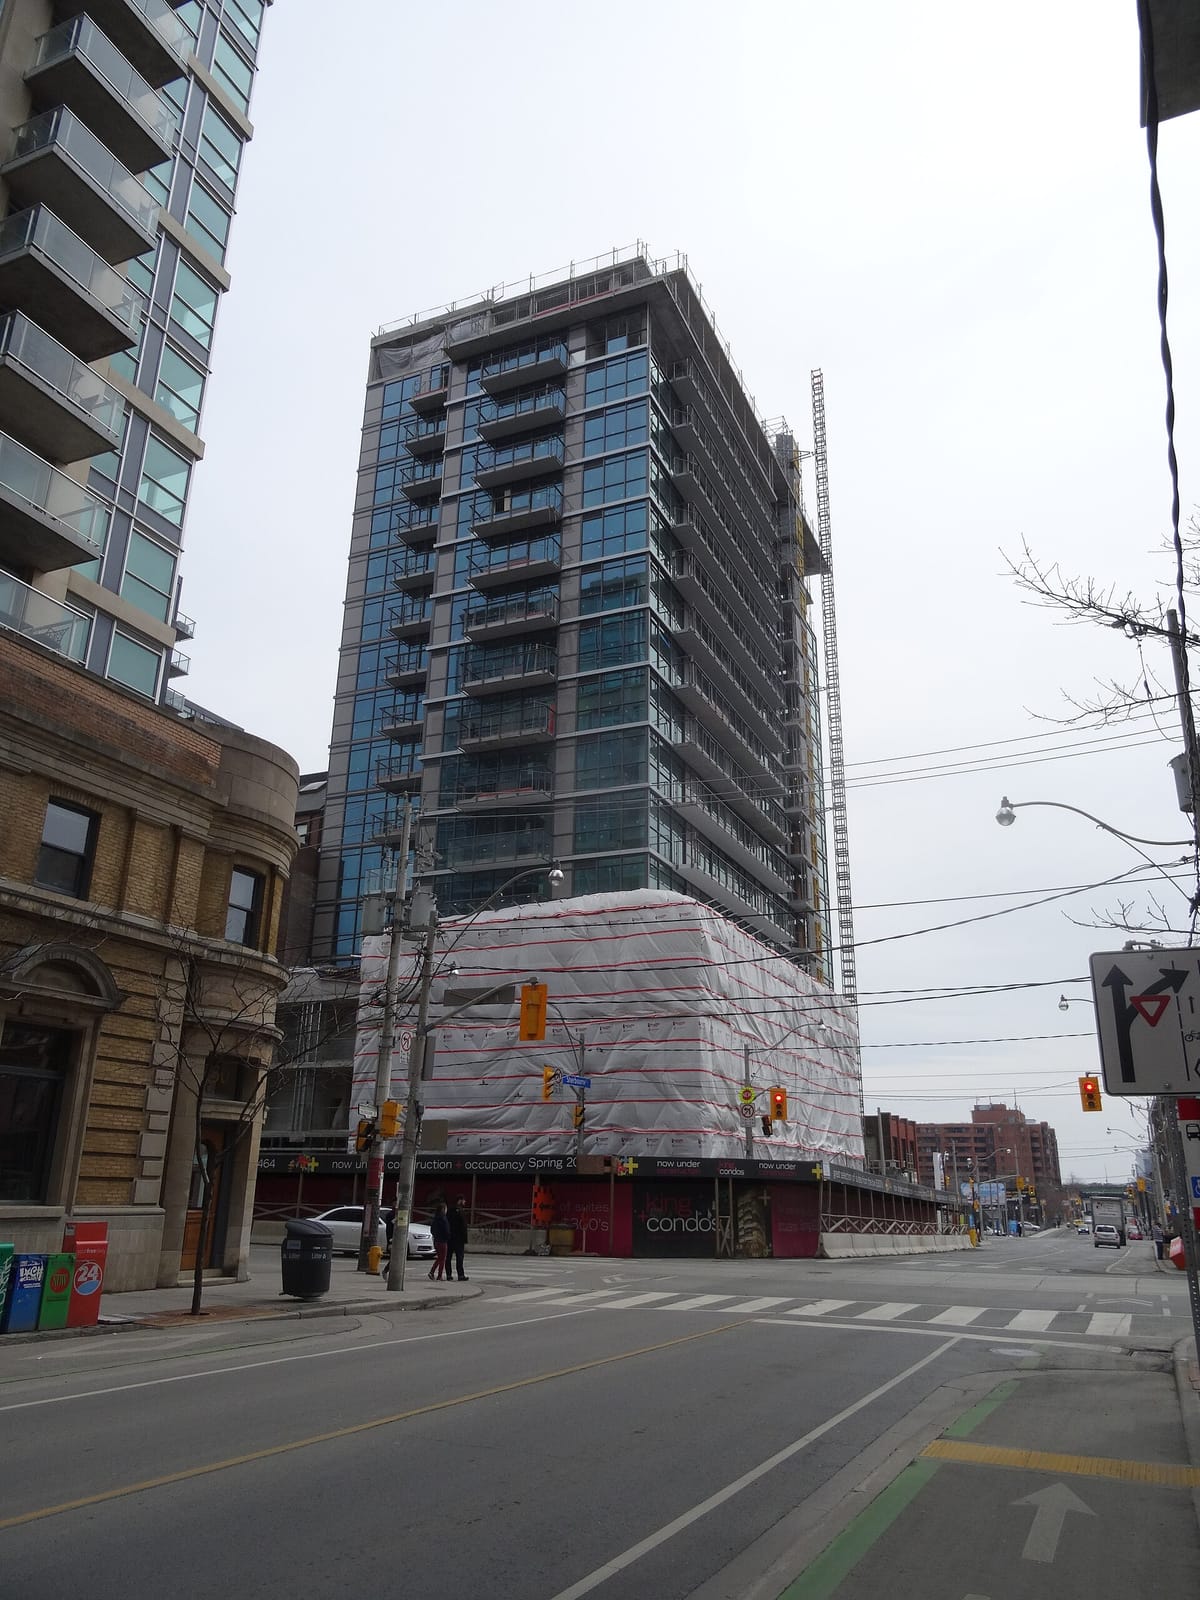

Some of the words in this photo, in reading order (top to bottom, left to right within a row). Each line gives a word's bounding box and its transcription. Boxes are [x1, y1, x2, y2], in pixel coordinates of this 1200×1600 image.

[331, 1161, 352, 1169] now
[387, 1159, 453, 1170] coruction
[464, 1160, 526, 1171] occupancy
[528, 1157, 563, 1169] Spring
[656, 1160, 675, 1168] now
[676, 1160, 701, 1168] under
[775, 1162, 797, 1170] under
[719, 1168, 745, 1176] condos
[646, 1209, 719, 1232] condos
[78, 1265, 99, 1282] 24
